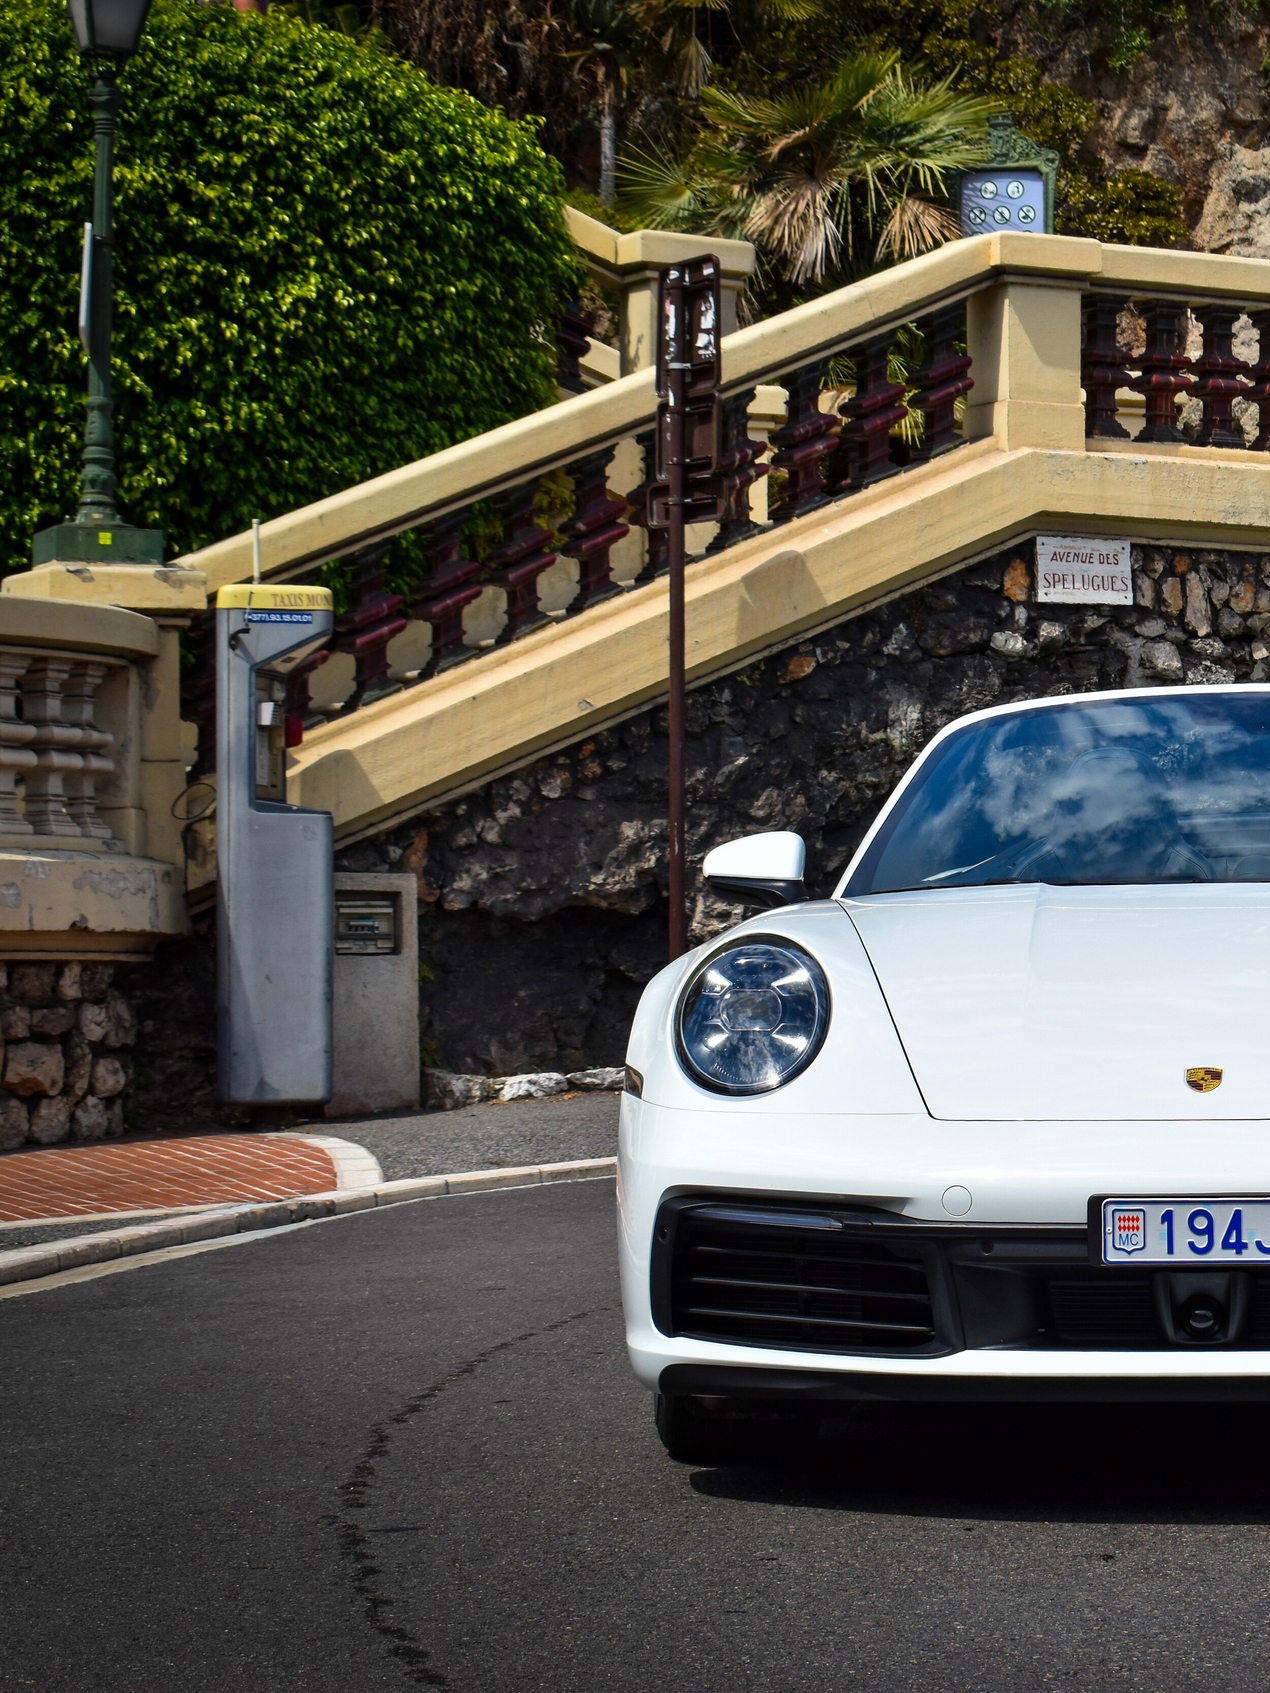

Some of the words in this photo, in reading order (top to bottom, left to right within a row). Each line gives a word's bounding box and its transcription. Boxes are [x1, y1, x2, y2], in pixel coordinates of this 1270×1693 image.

[1050, 551, 1094, 564] AVENUE
[1099, 553, 1119, 565] DES
[1043, 573, 1128, 592] SPELUGUES
[272, 593, 304, 607] TAXIS
[306, 593, 333, 606] MON
[1118, 1233, 1139, 1247] MC
